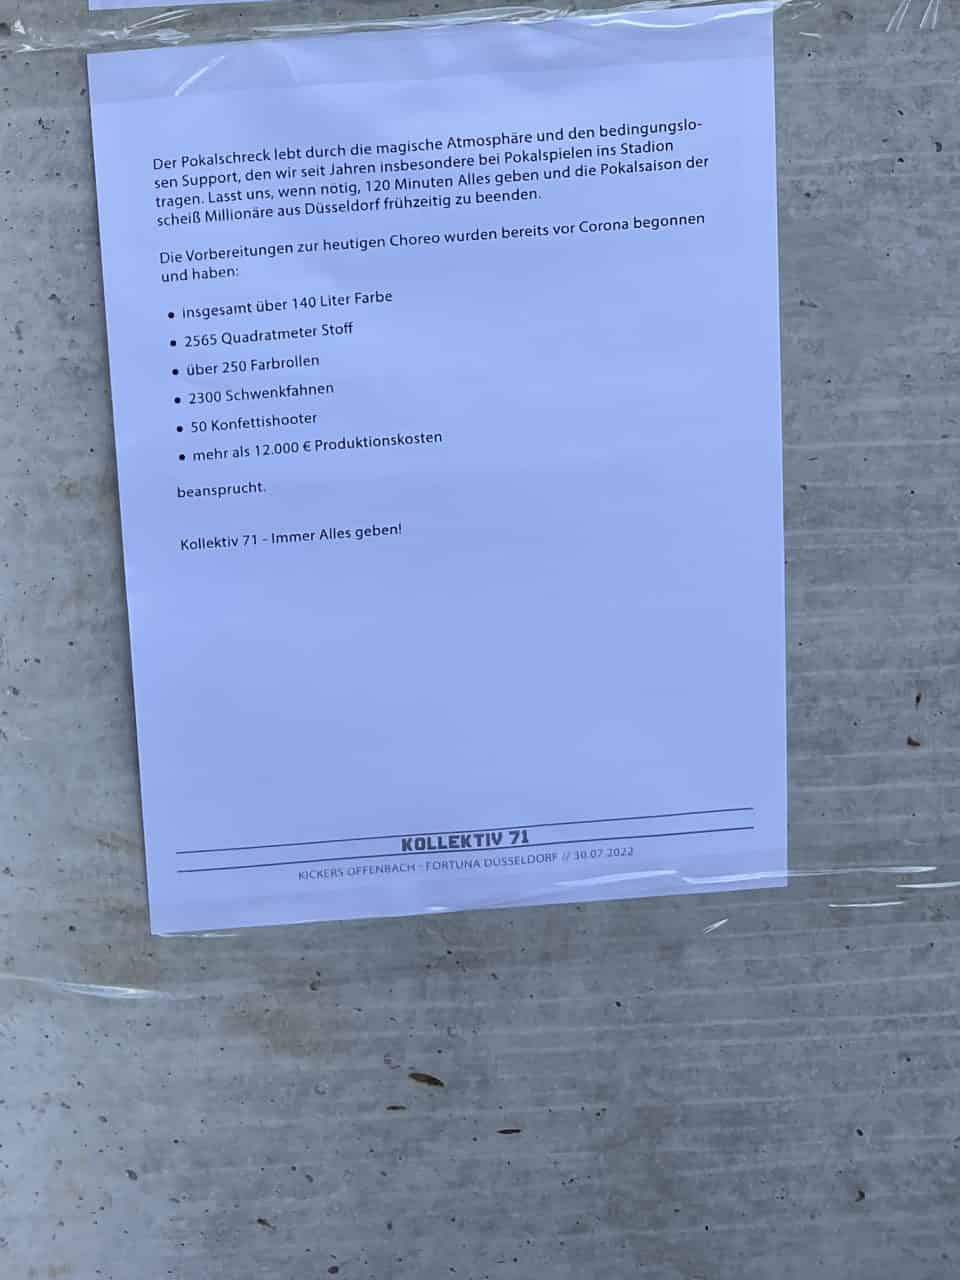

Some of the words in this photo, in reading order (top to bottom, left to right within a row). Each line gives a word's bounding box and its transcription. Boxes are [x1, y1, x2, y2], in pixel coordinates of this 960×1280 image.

[152, 158, 177, 170] Der
[180, 149, 271, 167] Pokalschreck
[274, 147, 302, 160] lebt
[305, 144, 346, 158] durch
[350, 143, 372, 155] die
[376, 138, 443, 155] magische
[446, 131, 533, 148] Atmosphäre
[536, 127, 564, 142] und
[568, 126, 595, 139] den
[599, 118, 702, 137] bedingungslo-
[155, 195, 204, 209] tragen.
[208, 190, 243, 203] Lasst
[246, 189, 274, 200] uns,
[277, 186, 316, 197] wenn
[320, 182, 361, 196] nötig,
[365, 179, 390, 192] 120
[394, 177, 453, 190] Minuten
[457, 172, 491, 186] Alles
[494, 169, 539, 186] geben
[543, 165, 571, 179] und
[574, 164, 597, 177] die
[600, 159, 682, 175] Pokalsaison
[685, 155, 709, 168] der
[159, 251, 183, 264] Die
[184, 244, 293, 261] Vorbereitungen
[296, 242, 319, 252] zur
[322, 238, 386, 251] heutigen
[389, 234, 440, 246] Choreo
[443, 228, 497, 242] wurden
[501, 224, 549, 239] bereits
[552, 224, 575, 235] vor
[578, 217, 629, 232] Corona
[633, 215, 705, 230] begonnen
[161, 268, 188, 282] und
[191, 266, 239, 280] haben:
[182, 302, 252, 320] insgesamt
[256, 299, 288, 312] über
[292, 296, 316, 309] 140
[320, 295, 351, 307] Liter
[354, 290, 392, 304] Farbe
[184, 333, 217, 347] 2565
[220, 327, 317, 344] Quadratmeter
[321, 321, 353, 336] Stoff
[186, 363, 218, 376] über
[221, 360, 247, 373] 250
[250, 354, 320, 371] Farbrollen
[188, 391, 221, 404] 2300
[225, 384, 334, 401] Schwenkfahnen
[191, 420, 207, 433] 50
[210, 414, 320, 431] Konfettishooter
[192, 447, 228, 461] mehr
[232, 445, 250, 458] als
[255, 441, 299, 456] 12.000
[302, 440, 311, 452] €
[314, 433, 442, 451] Produktionskosten
[176, 481, 266, 498] beansprucht.
[180, 536, 238, 550] Kollektiv
[242, 534, 257, 546] 71
[271, 532, 316, 544] Immer
[319, 527, 351, 540] Alles
[354, 523, 402, 540] geben!
[401, 831, 502, 852] KOLLEKTIV
[510, 829, 529, 846] 71
